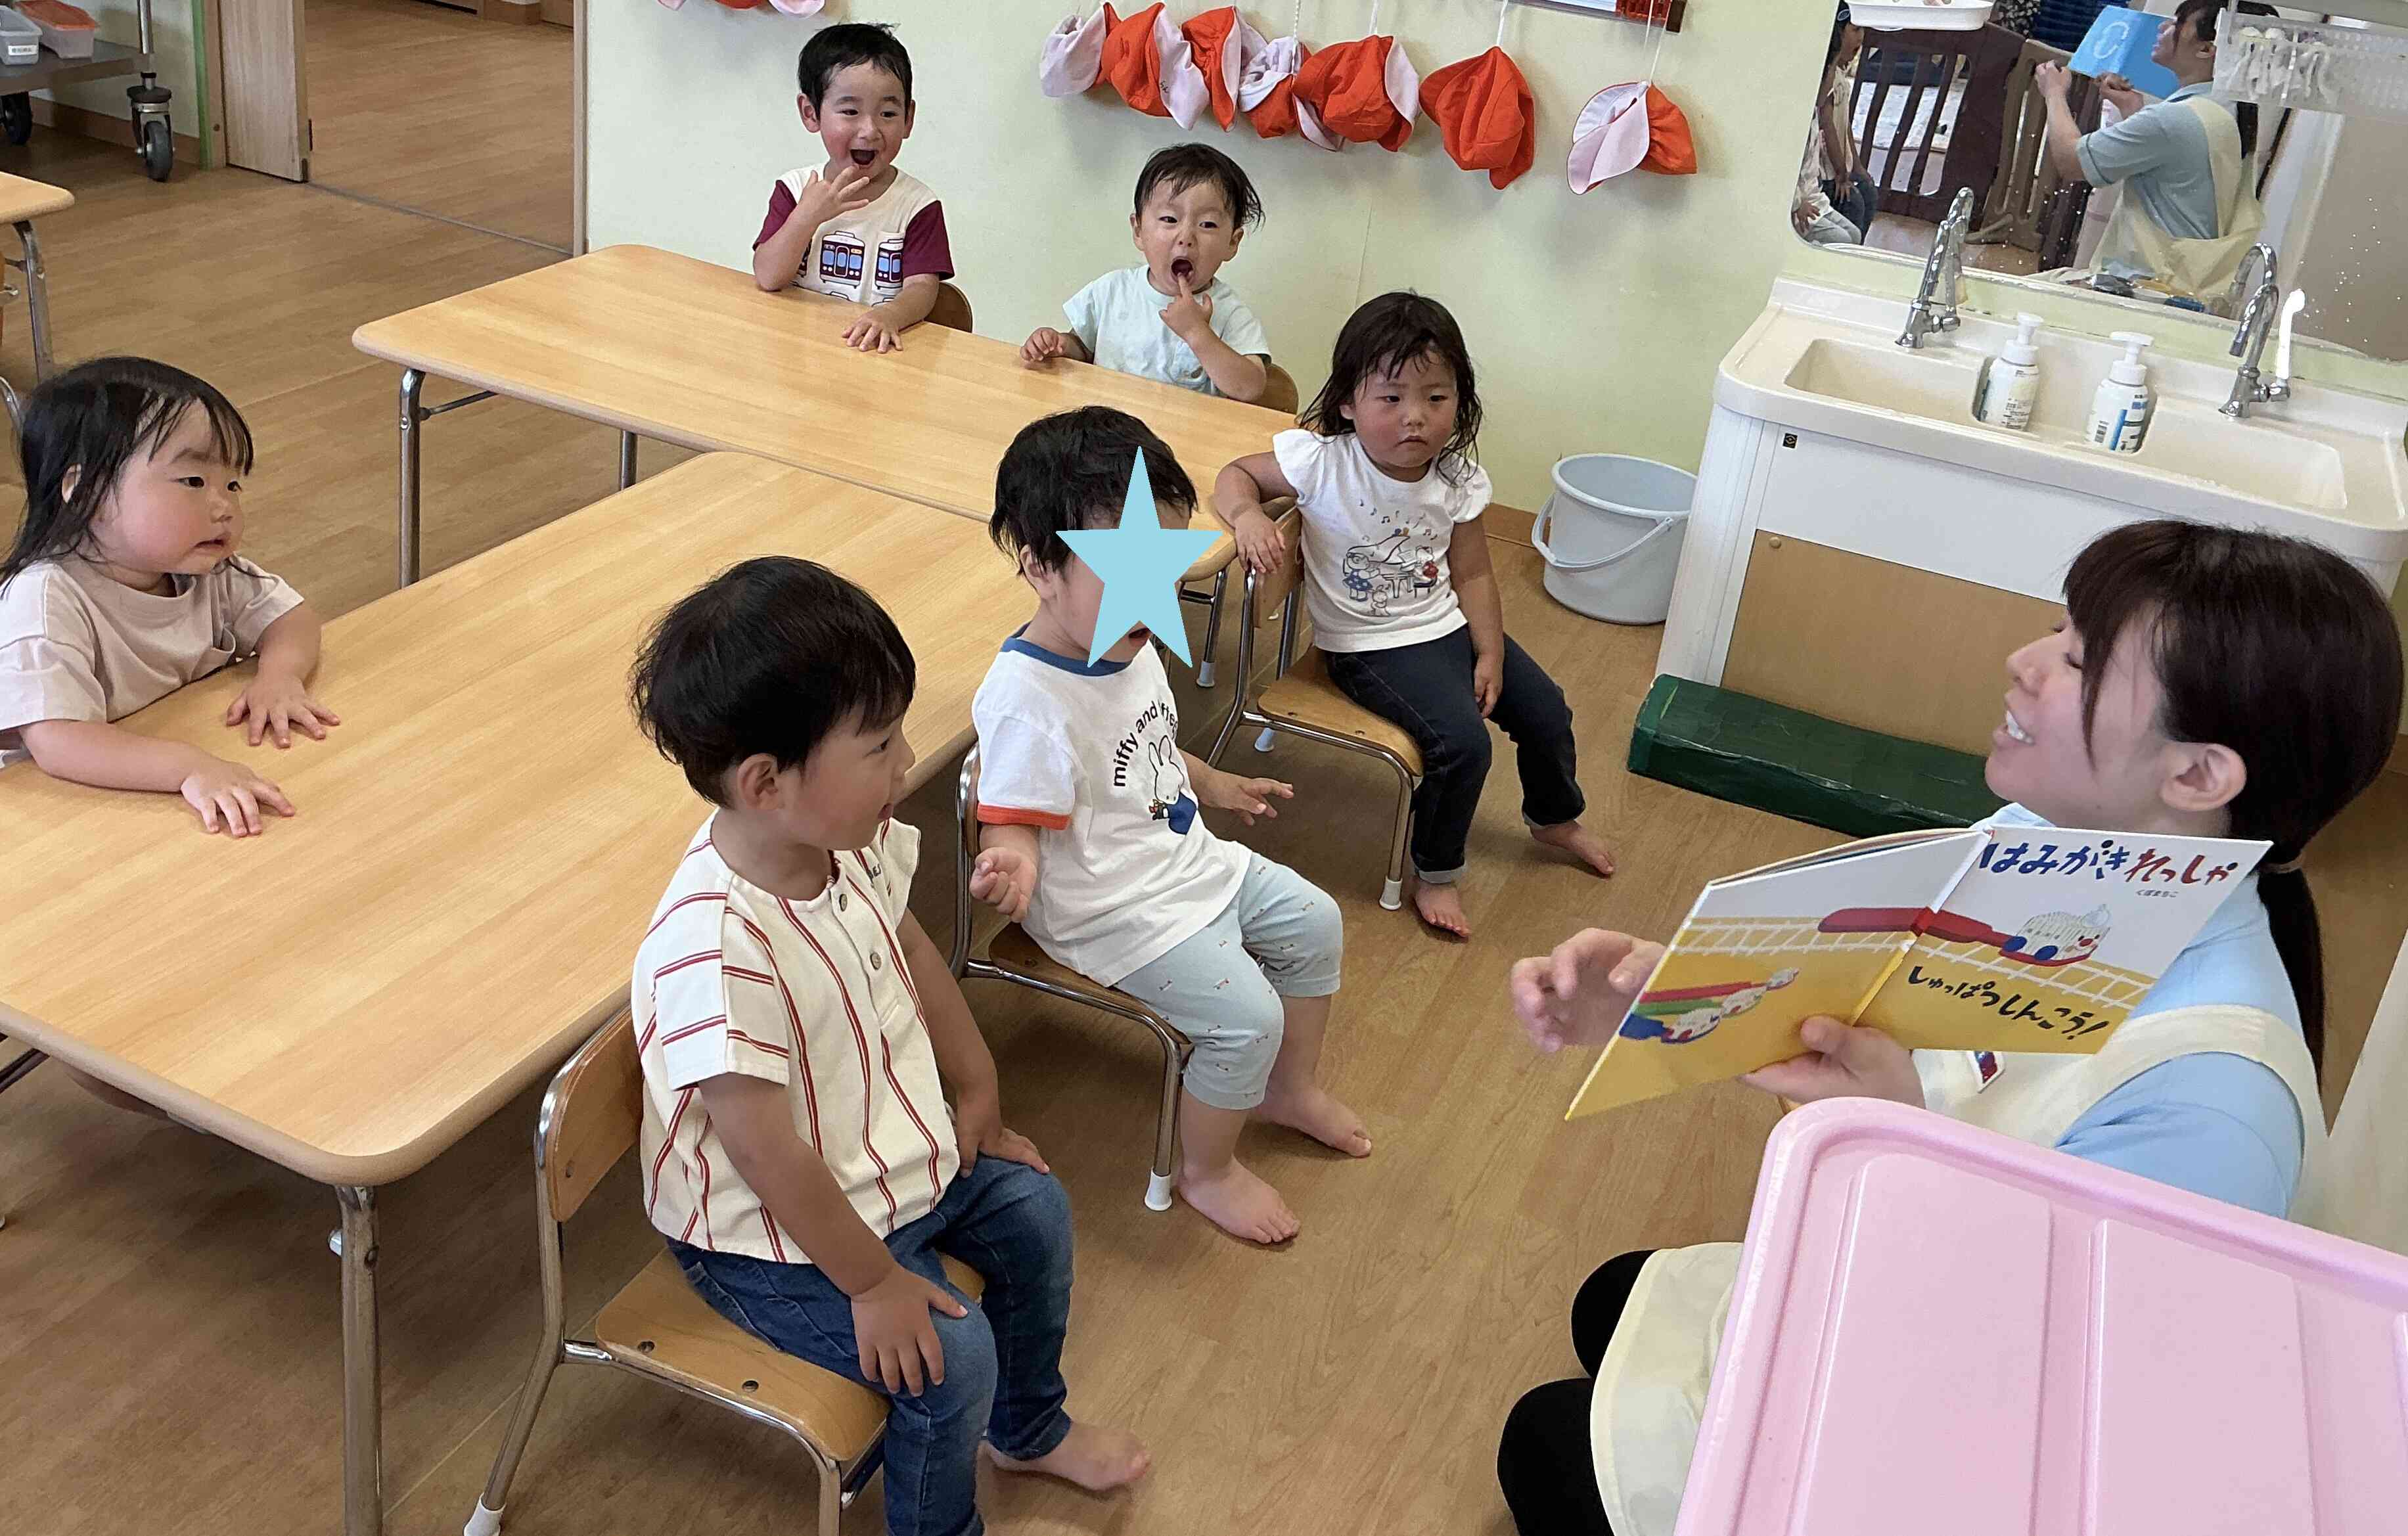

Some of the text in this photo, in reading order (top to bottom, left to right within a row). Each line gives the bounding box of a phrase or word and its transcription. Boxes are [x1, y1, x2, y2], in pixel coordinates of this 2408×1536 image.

[1113, 700, 1158, 787] miffy and
[1979, 840, 2238, 886] はみがきれっしゃ
